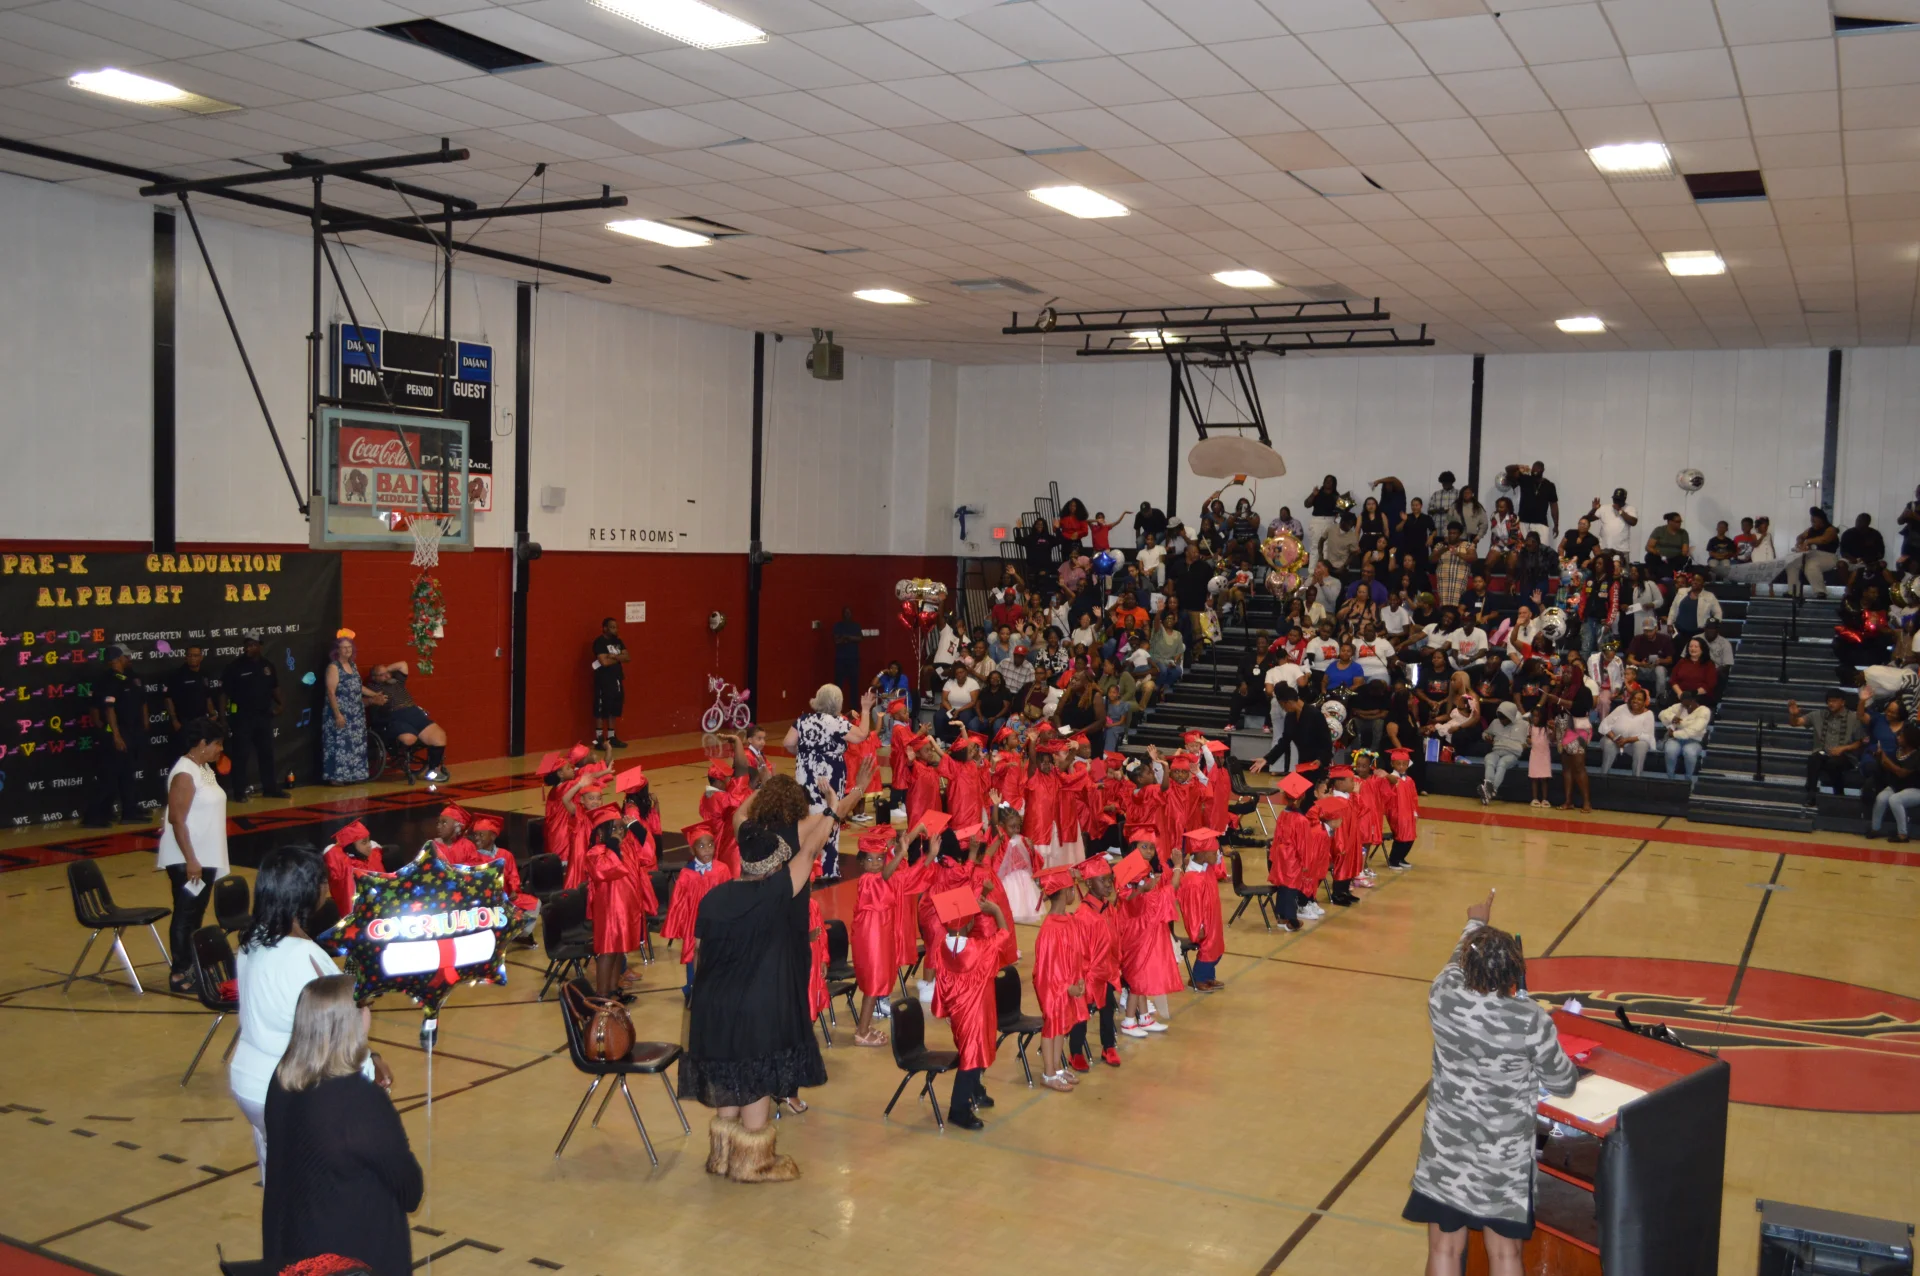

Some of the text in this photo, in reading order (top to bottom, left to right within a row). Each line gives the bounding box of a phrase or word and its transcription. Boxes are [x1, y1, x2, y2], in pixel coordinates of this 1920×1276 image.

[462, 356, 488, 369] DASANI
[406, 383, 434, 397] PERIOD
[453, 381, 487, 400] GUEST
[376, 472, 461, 496] BAKER
[376, 493, 461, 506] MIDDLE CHOL
[589, 528, 674, 543] RESTROOMS
[2, 553, 282, 575] PRE-K GRADUATION
[37, 583, 271, 607] ALPHABET RAP
[115, 630, 182, 642] KINDERGARTEN
[188, 629, 206, 639] WILL
[210, 628, 221, 638] BE
[223, 627, 239, 637] THE
[267, 625, 283, 635] FOR
[285, 624, 300, 633] ME!
[149, 650, 164, 660] DID
[28, 776, 83, 791] WE FINISH
[13, 815, 31, 825] WE
[42, 811, 63, 822] HAD
[71, 809, 79, 817] A
